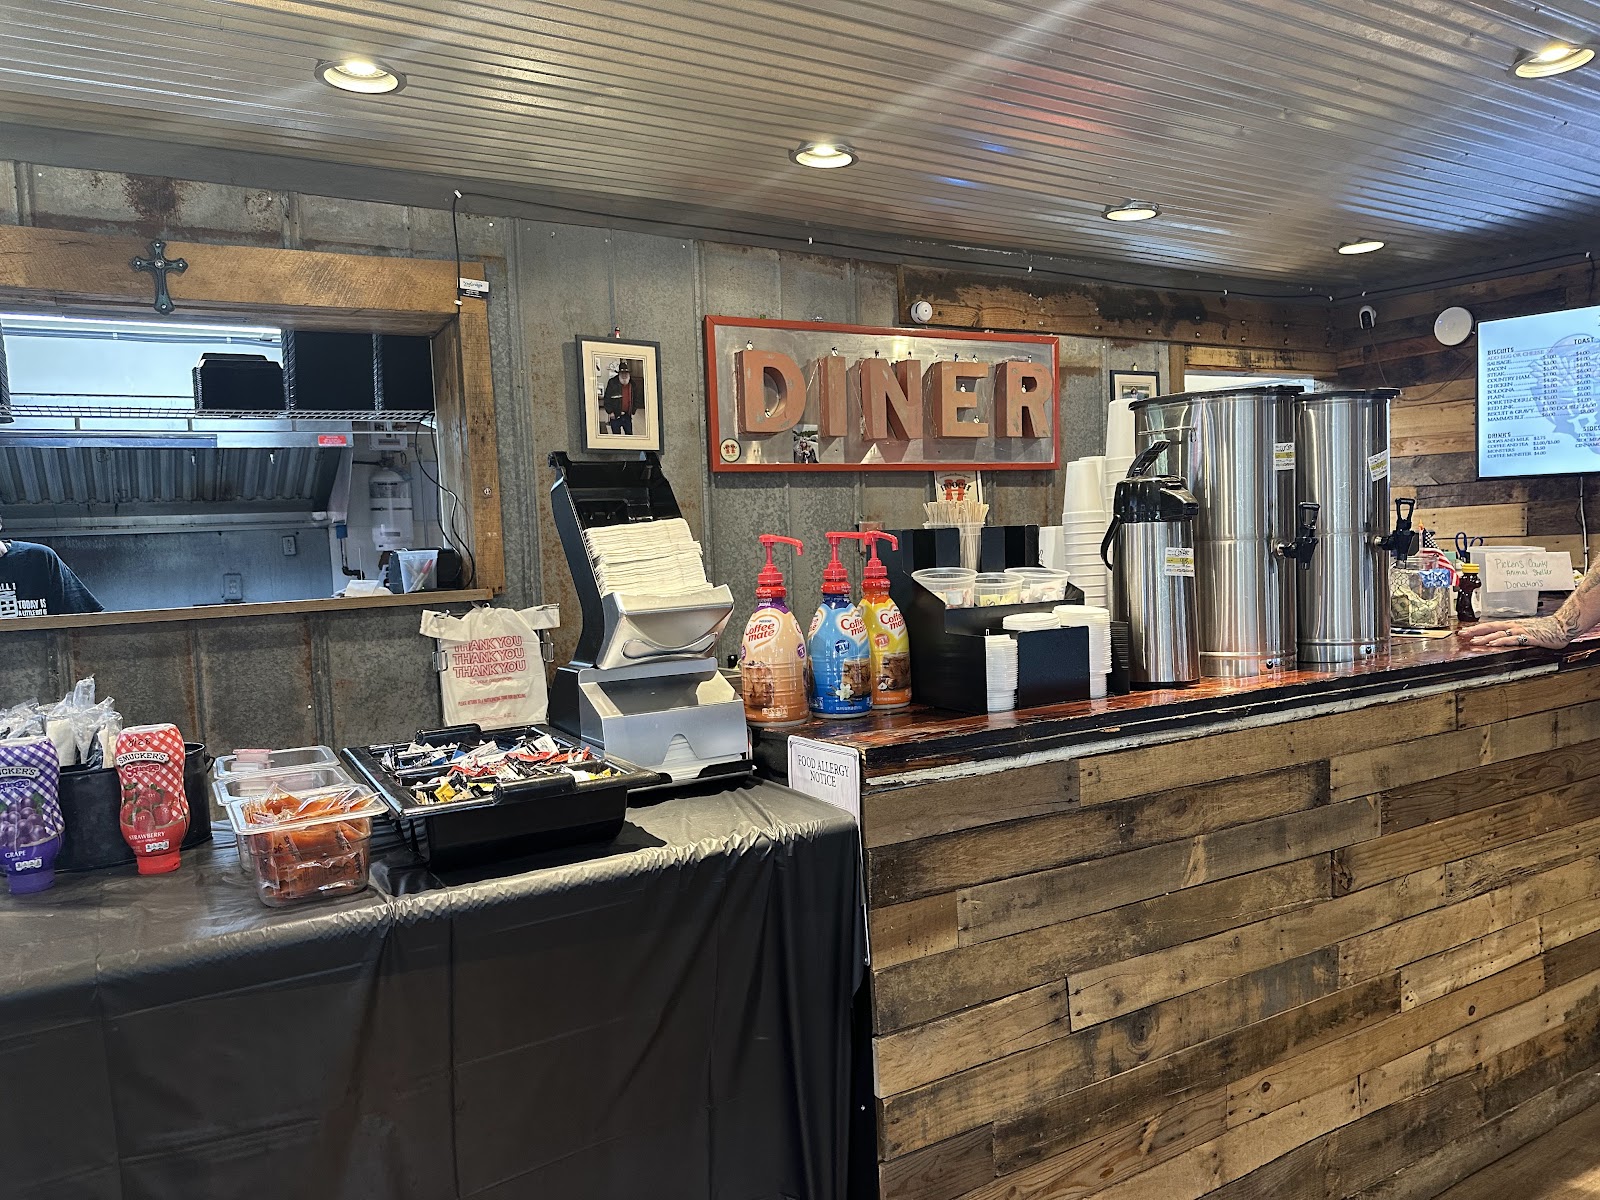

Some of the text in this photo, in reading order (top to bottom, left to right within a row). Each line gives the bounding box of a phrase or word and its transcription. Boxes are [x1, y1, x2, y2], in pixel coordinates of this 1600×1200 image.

[1574, 337, 1594, 345] TOAST
[1487, 347, 1514, 356] BISCUITS
[736, 349, 1053, 439] DINER
[1527, 558, 1548, 569] County
[1504, 579, 1544, 590] Donations
[17, 600, 39, 610] TODAY
[40, 598, 47, 609] IS
[745, 623, 775, 636] Coffee
[748, 630, 775, 642] mate
[497, 636, 523, 650] YOU
[452, 648, 525, 665] THANK YOU
[453, 660, 526, 679] THANK YOU
[117, 752, 166, 764] SMUCKER'S
[0, 767, 36, 776] CKER'S
[125, 764, 160, 778] Squeeze
[798, 754, 850, 777] FOOD ALLERGY
[810, 770, 837, 787] NOTICE
[0, 779, 30, 792] queeze
[128, 831, 166, 840] STRAWBERRY
[4, 850, 26, 858] GRAPE
